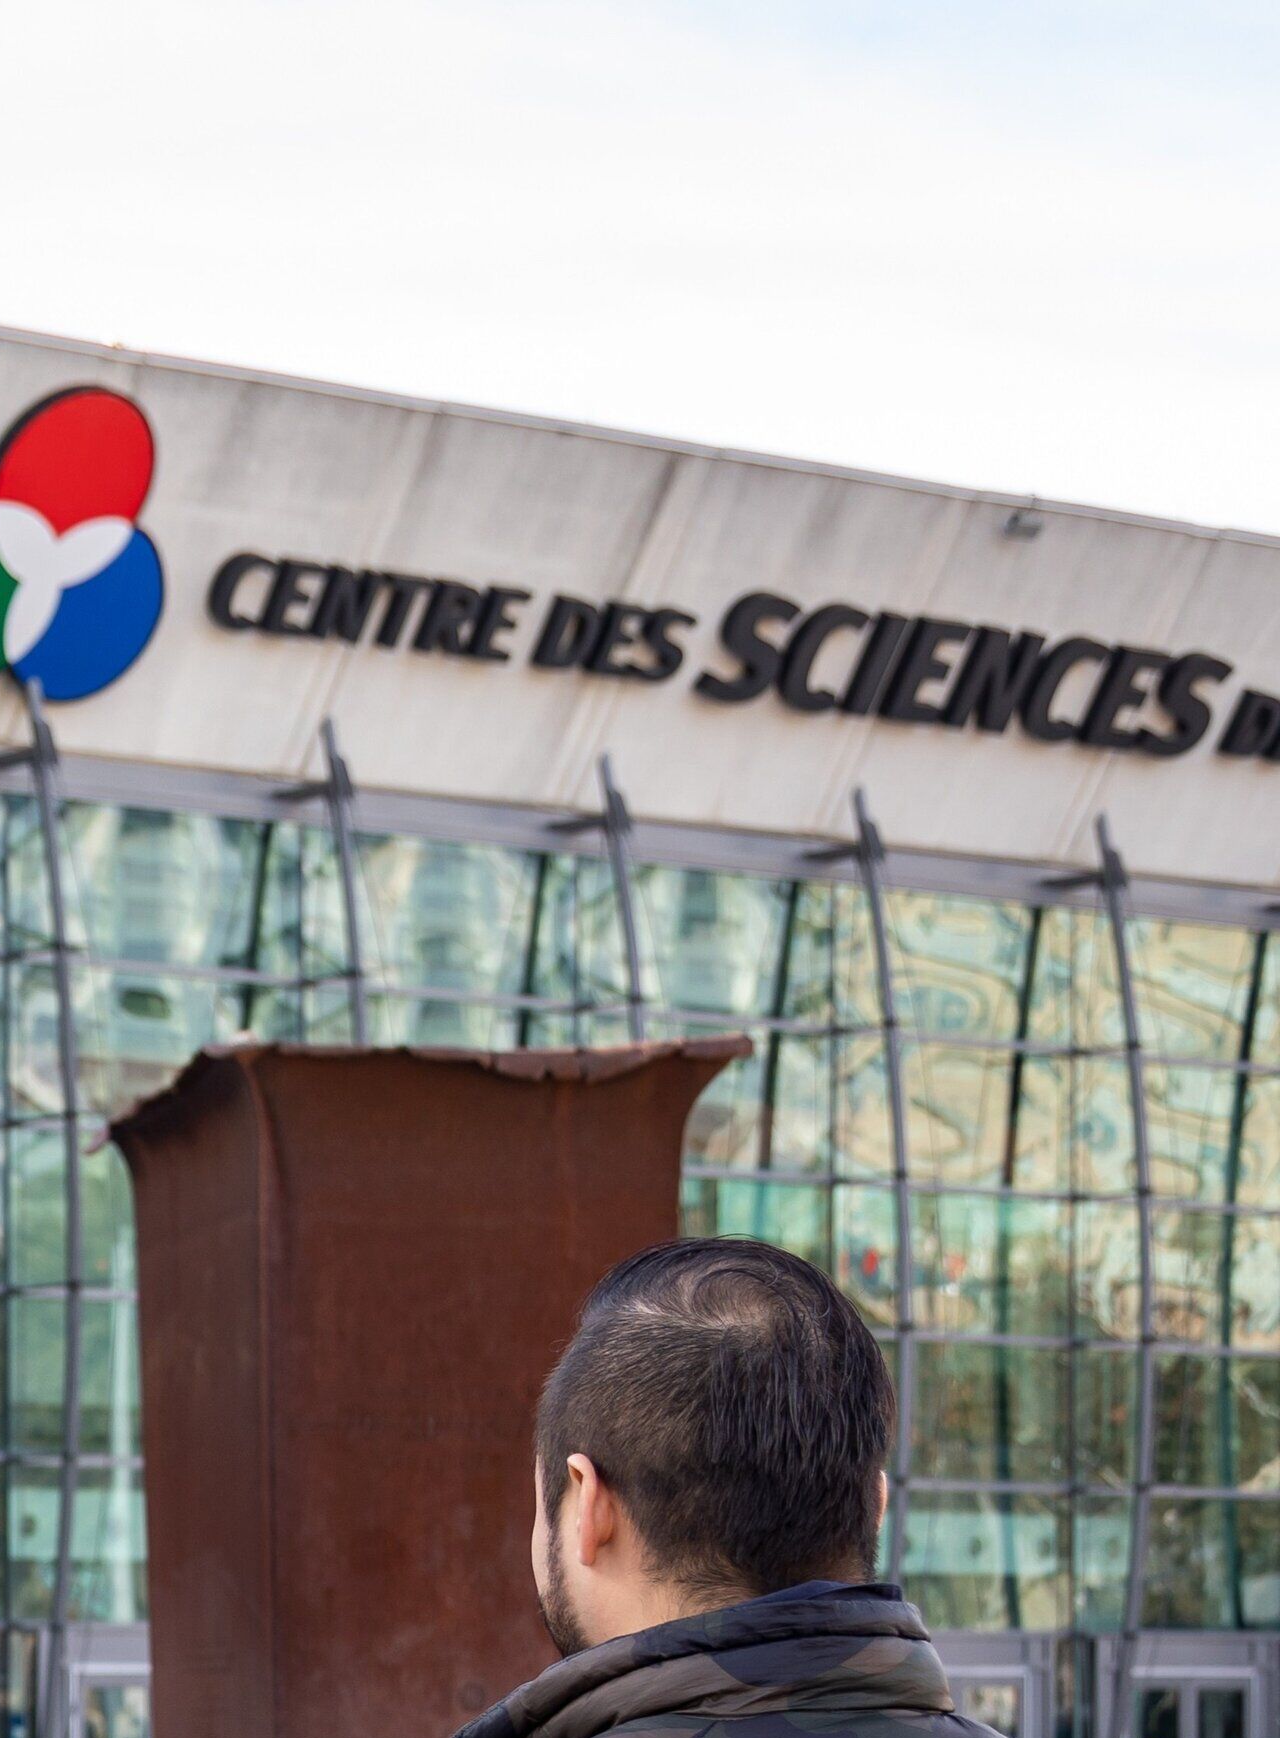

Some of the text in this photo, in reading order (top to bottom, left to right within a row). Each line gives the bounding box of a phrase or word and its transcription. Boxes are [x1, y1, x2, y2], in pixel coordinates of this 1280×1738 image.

[207, 553, 1280, 766] CENTRE DES SCIENCES D
